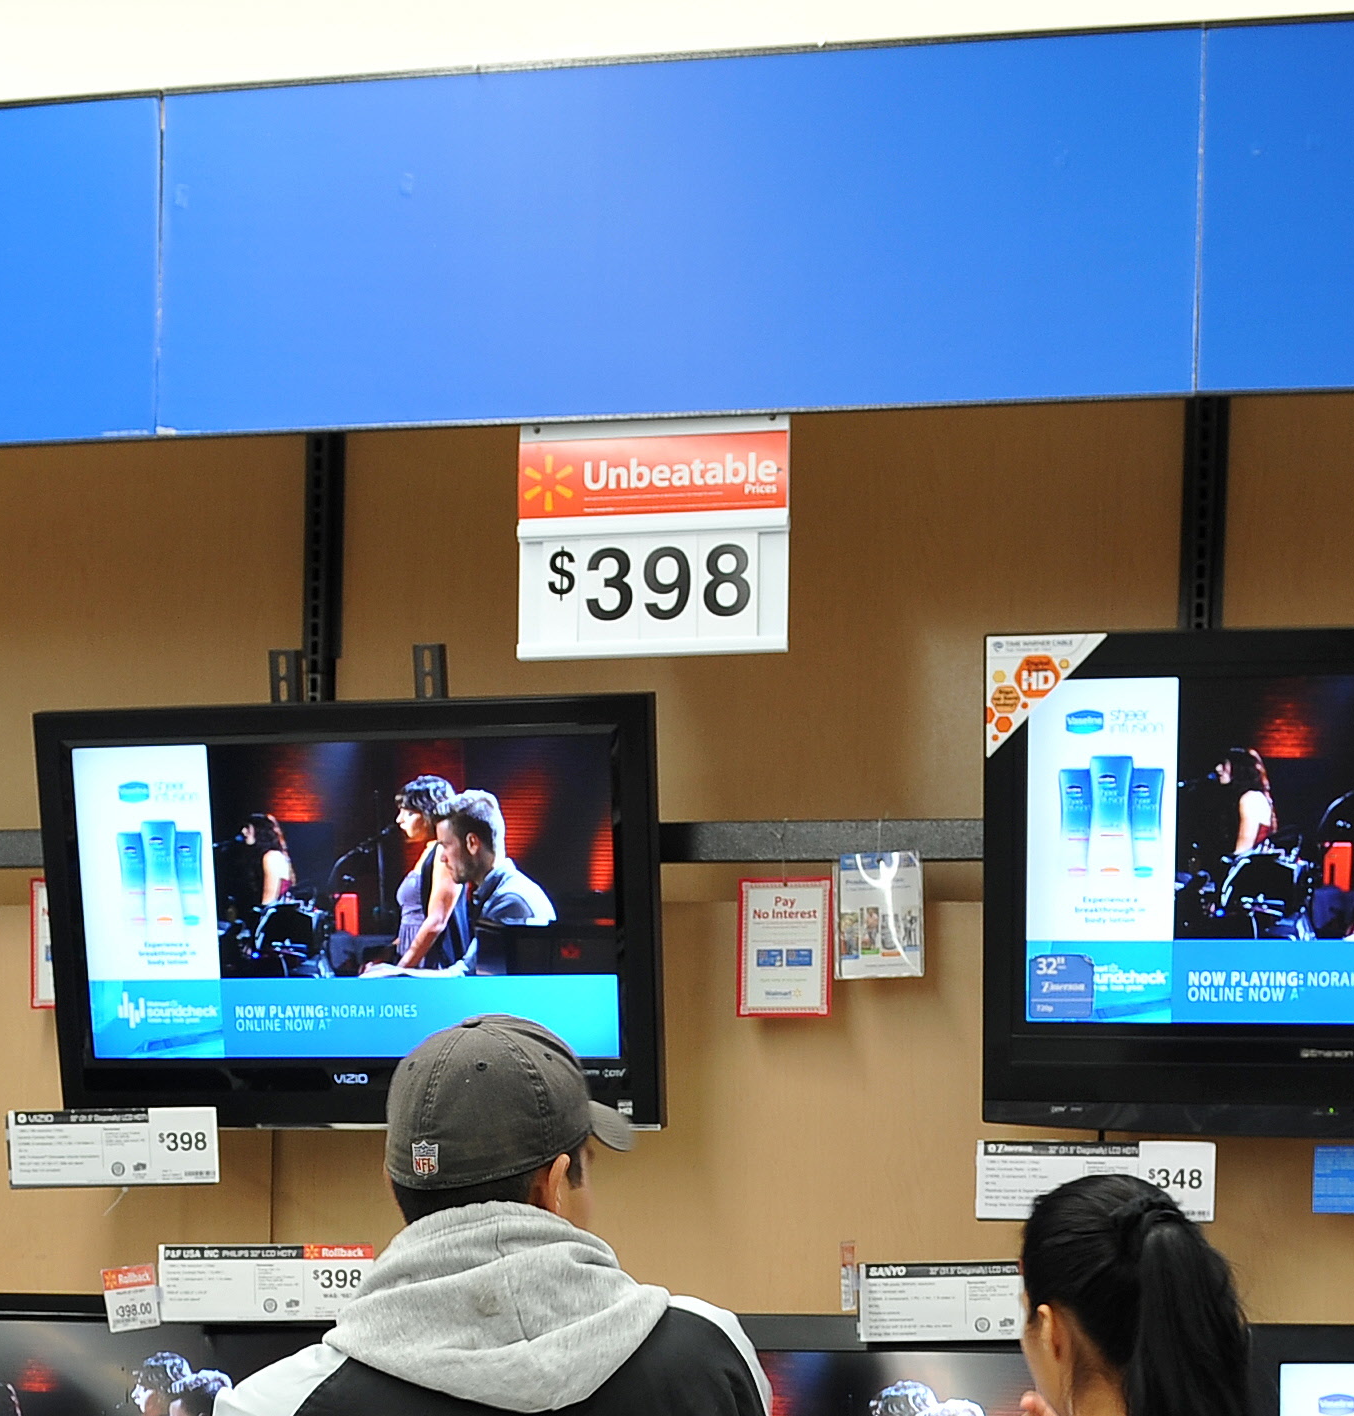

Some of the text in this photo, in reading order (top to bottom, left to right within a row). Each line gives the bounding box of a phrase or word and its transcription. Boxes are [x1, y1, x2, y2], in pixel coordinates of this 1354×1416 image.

[584, 452, 778, 490] Unbeatable
[744, 482, 778, 495] Prices
[548, 543, 751, 621] $398
[1021, 669, 1056, 691] HD
[774, 896, 796, 908] Pay
[753, 909, 818, 920] No Interest
[1094, 969, 1166, 984] undcheck
[1188, 971, 1224, 987] NOW
[1231, 971, 1304, 988] PLAYING:
[1188, 987, 1284, 1002] ONLINE NOW
[147, 1004, 217, 1018] soundcheck
[235, 1004, 418, 1018] NOW PLAYING: NORAH JONES
[235, 1019, 282, 1032] ONLINE
[285, 1019, 315, 1031] NOW
[333, 1072, 369, 1084] VIZIO
[158, 1131, 207, 1152] $398
[414, 1157, 436, 1173] NFL
[1148, 1168, 1203, 1190] $348
[183, 1249, 201, 1258] USA
[204, 1249, 219, 1258] INC
[261, 1250, 276, 1258] LCD
[321, 1247, 364, 1258] Rollback
[868, 1265, 907, 1277] SANYO
[312, 1269, 362, 1289] $398
